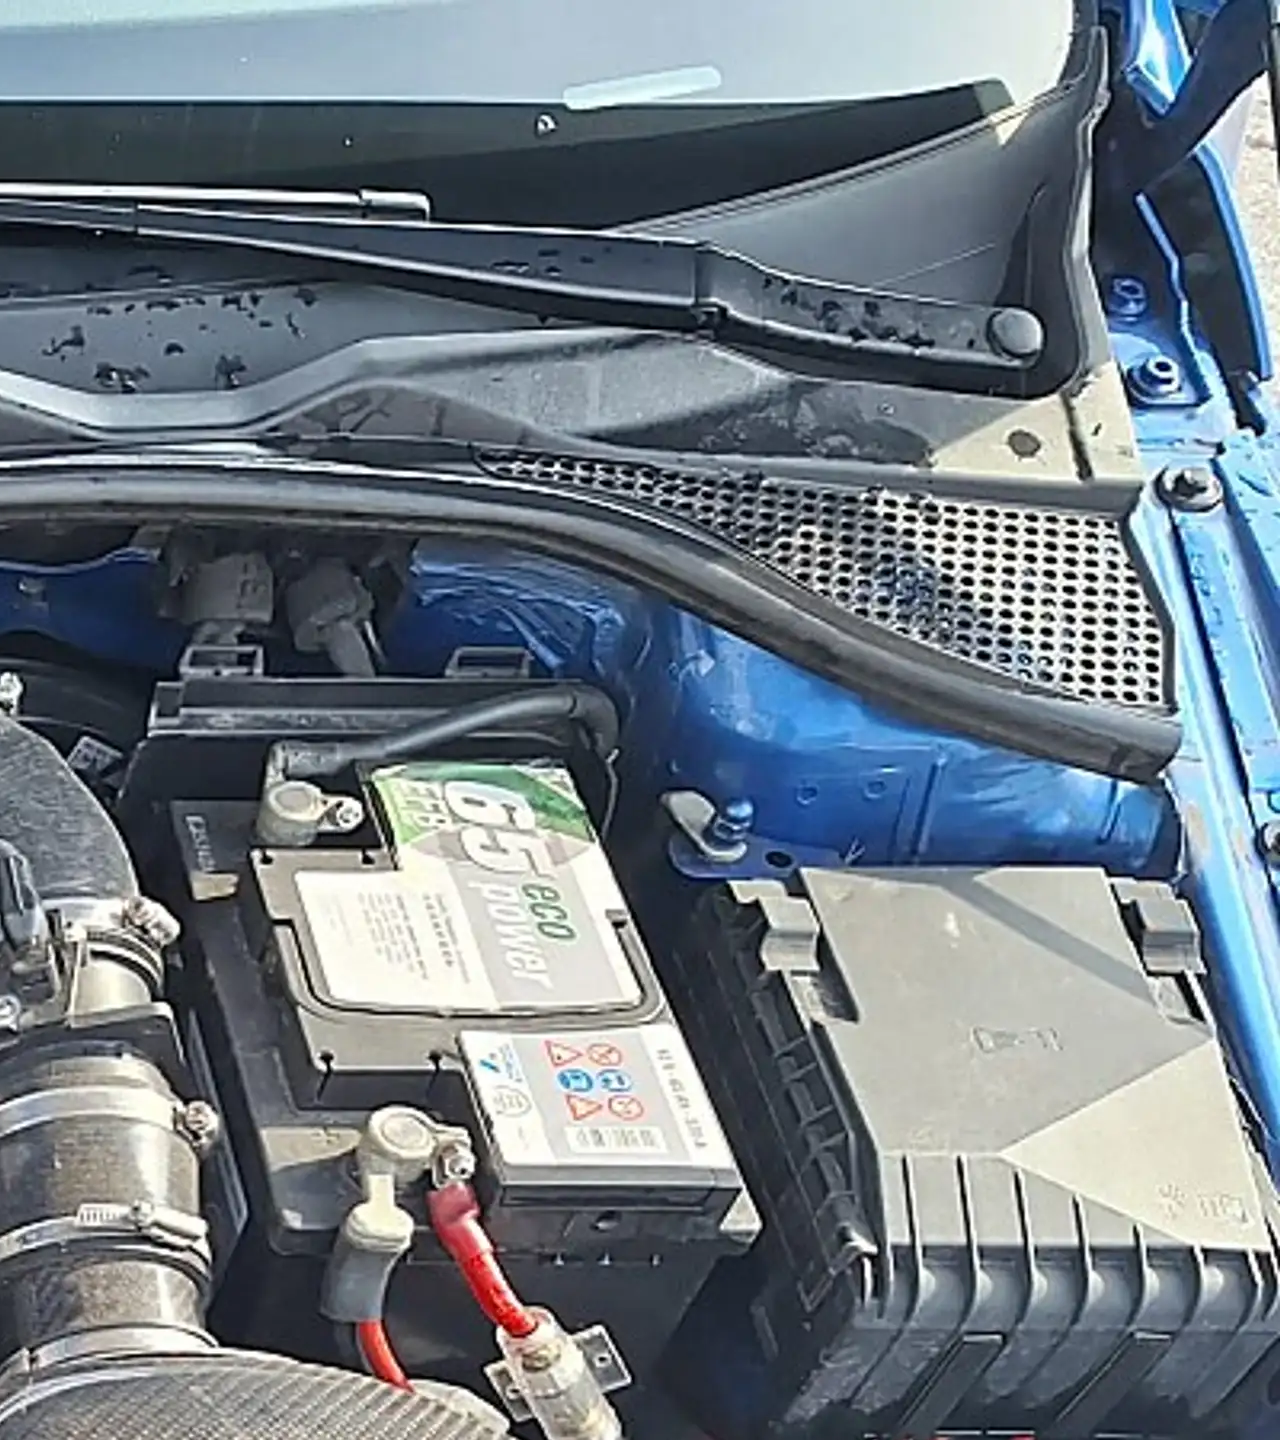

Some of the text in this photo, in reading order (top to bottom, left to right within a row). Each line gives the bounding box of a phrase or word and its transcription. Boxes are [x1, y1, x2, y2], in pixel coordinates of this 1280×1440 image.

[443, 780, 557, 878] 65
[468, 880, 554, 990] power
[521, 883, 576, 941] eco
